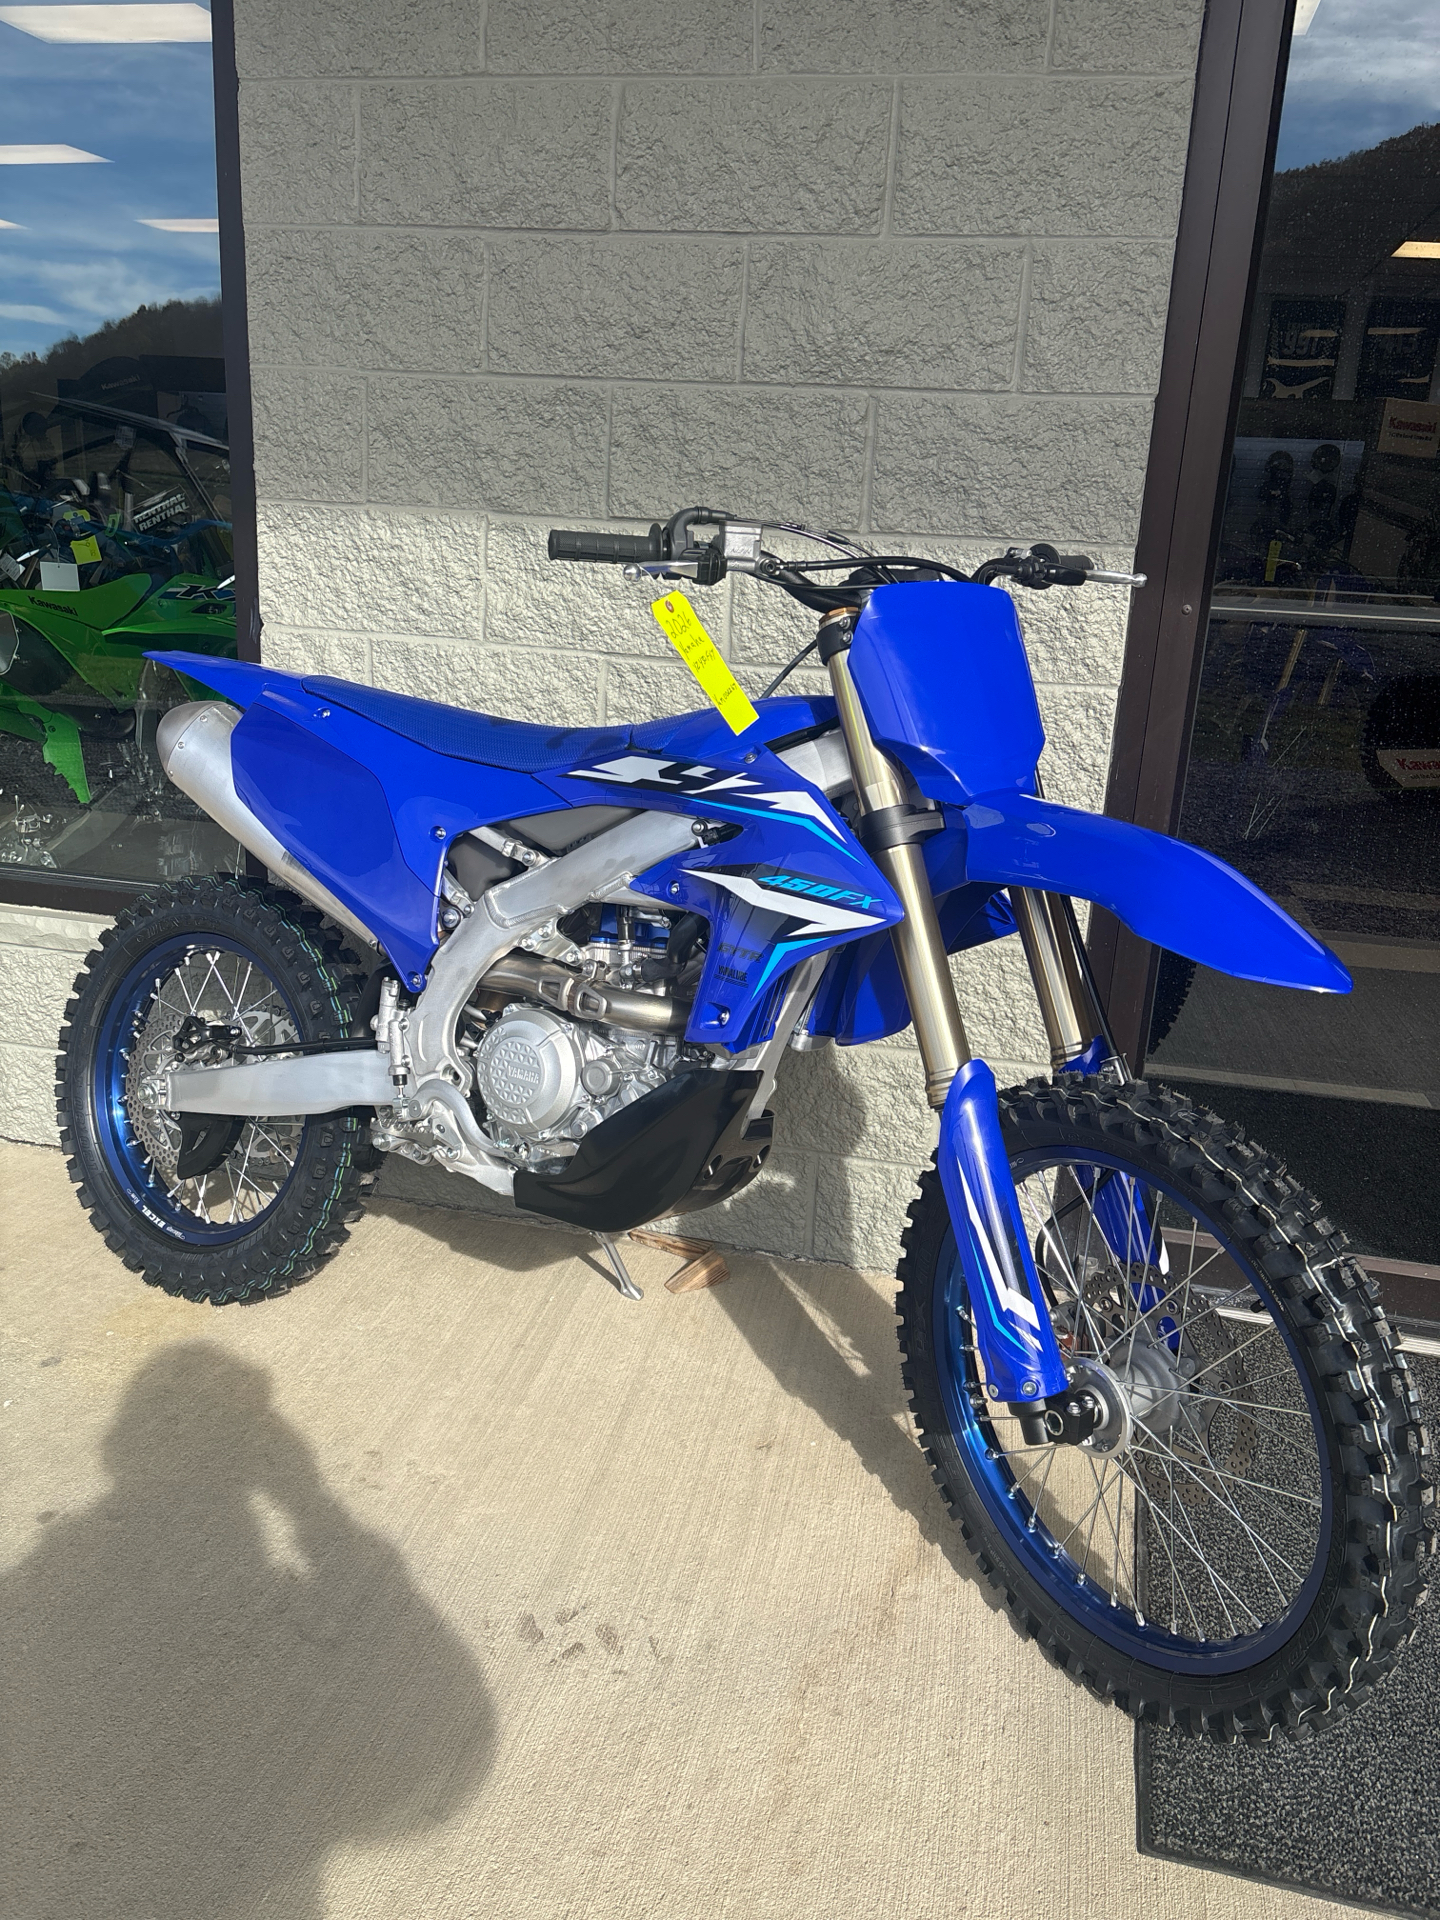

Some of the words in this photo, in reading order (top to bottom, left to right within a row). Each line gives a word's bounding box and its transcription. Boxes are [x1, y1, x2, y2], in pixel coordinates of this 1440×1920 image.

[100, 373, 141, 391] Kawasaki
[138, 501, 190, 532] RENTHAL
[27, 595, 79, 617] Kawasaki
[665, 611, 692, 639] 2026
[757, 874, 885, 909] 450FX
[717, 941, 765, 964] GYTR
[718, 964, 748, 982] YAMALUBE
[507, 1064, 540, 1085] YAMAHA
[141, 1204, 167, 1229] EXCEL
